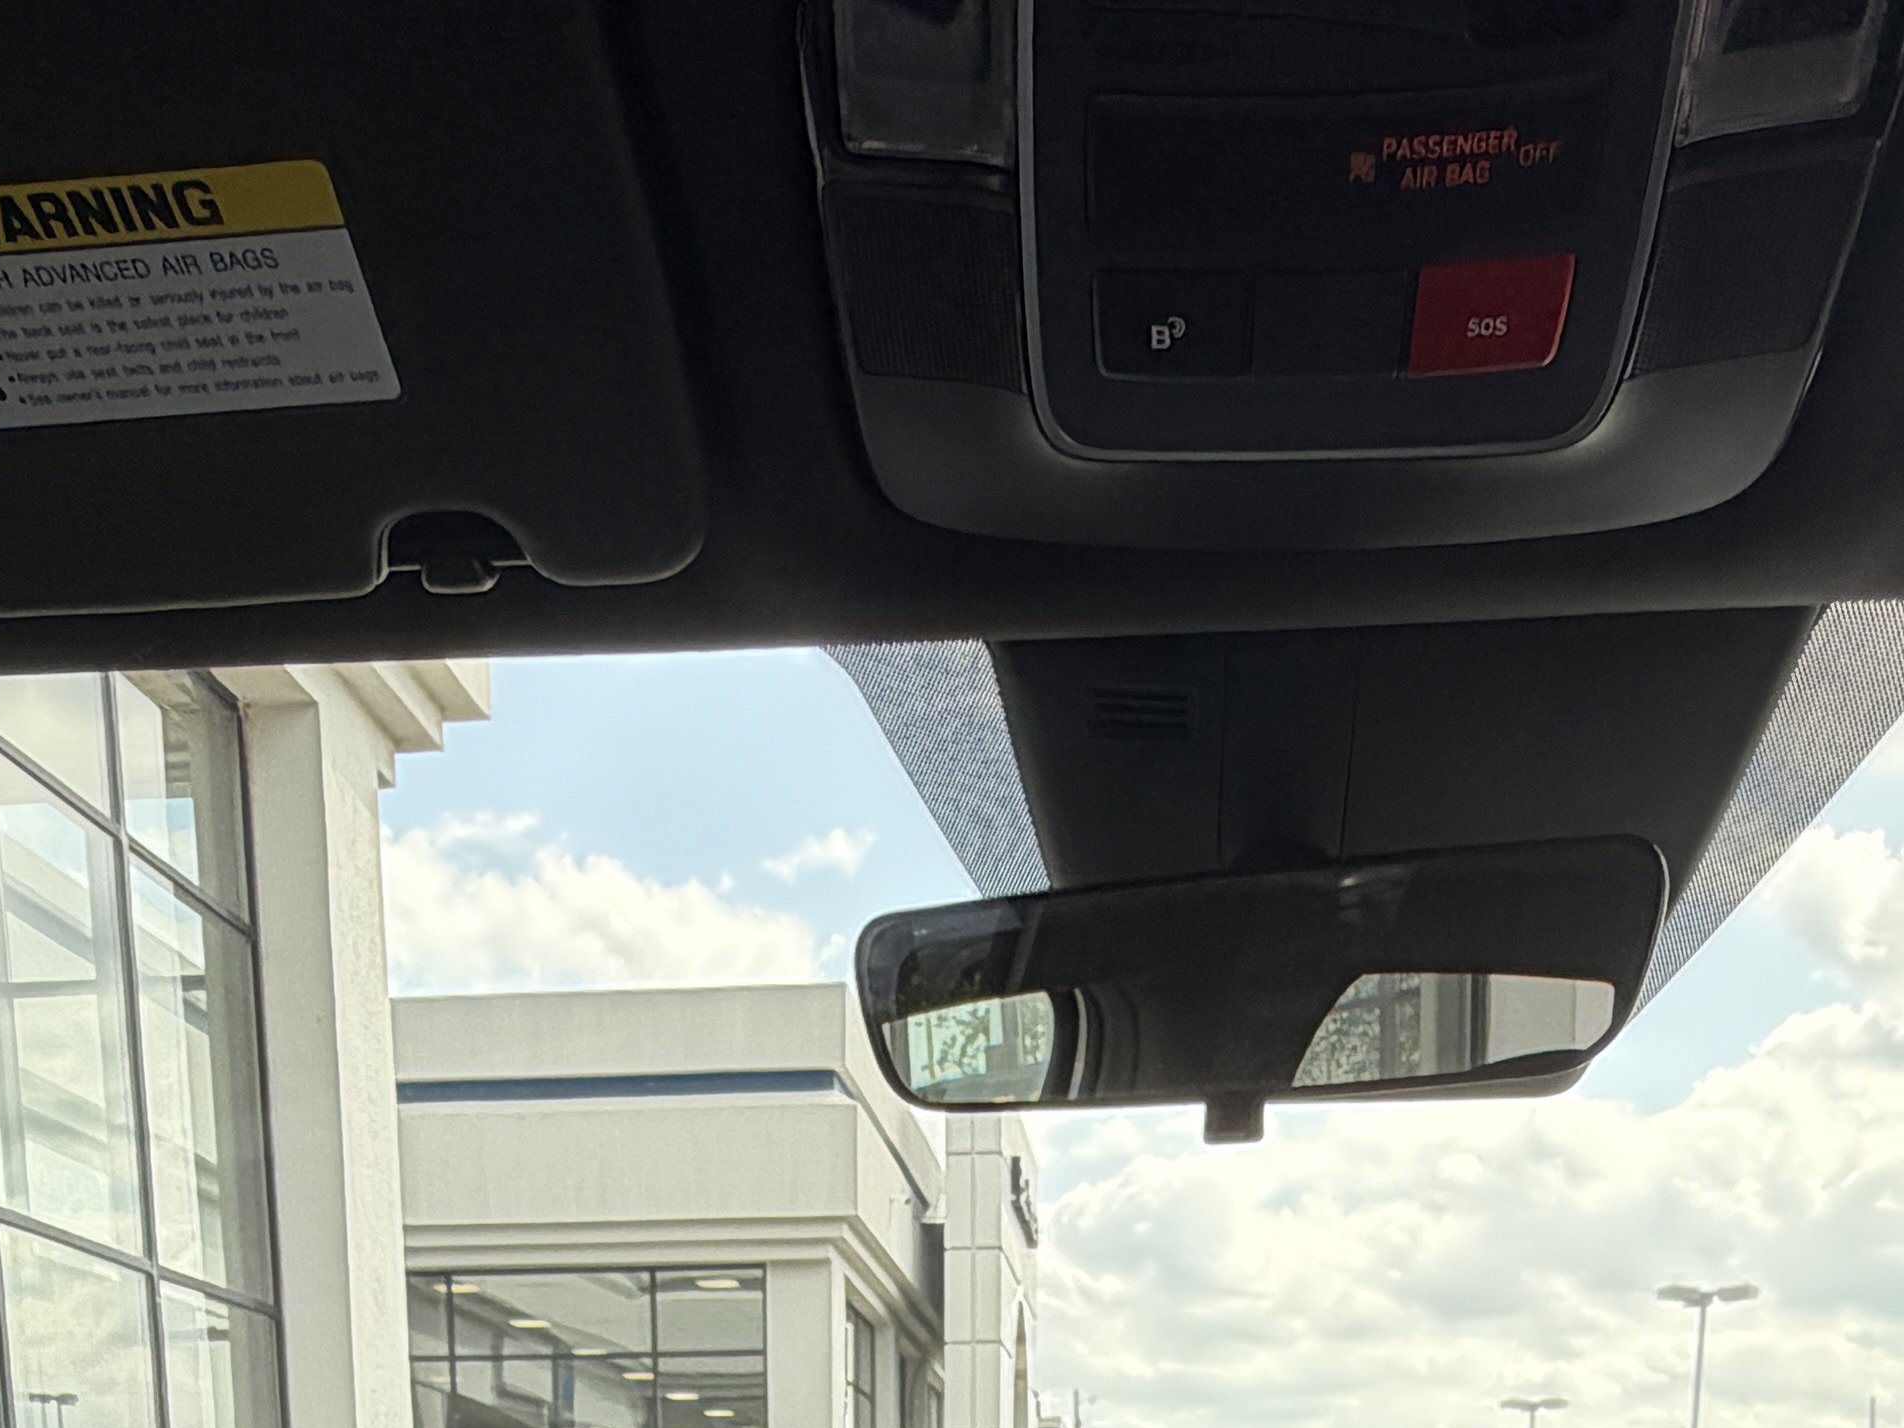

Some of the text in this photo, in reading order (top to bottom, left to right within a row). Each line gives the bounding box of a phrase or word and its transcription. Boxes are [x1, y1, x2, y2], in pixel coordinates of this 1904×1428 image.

[1382, 127, 1518, 161] PASSENGER
[1519, 140, 1562, 167] OFF
[1401, 160, 1491, 189] AIR BAG
[22, 257, 151, 288] ADVANCED
[162, 254, 203, 276] AIR
[209, 248, 279, 273] BAGS
[1467, 316, 1508, 337] SOS
